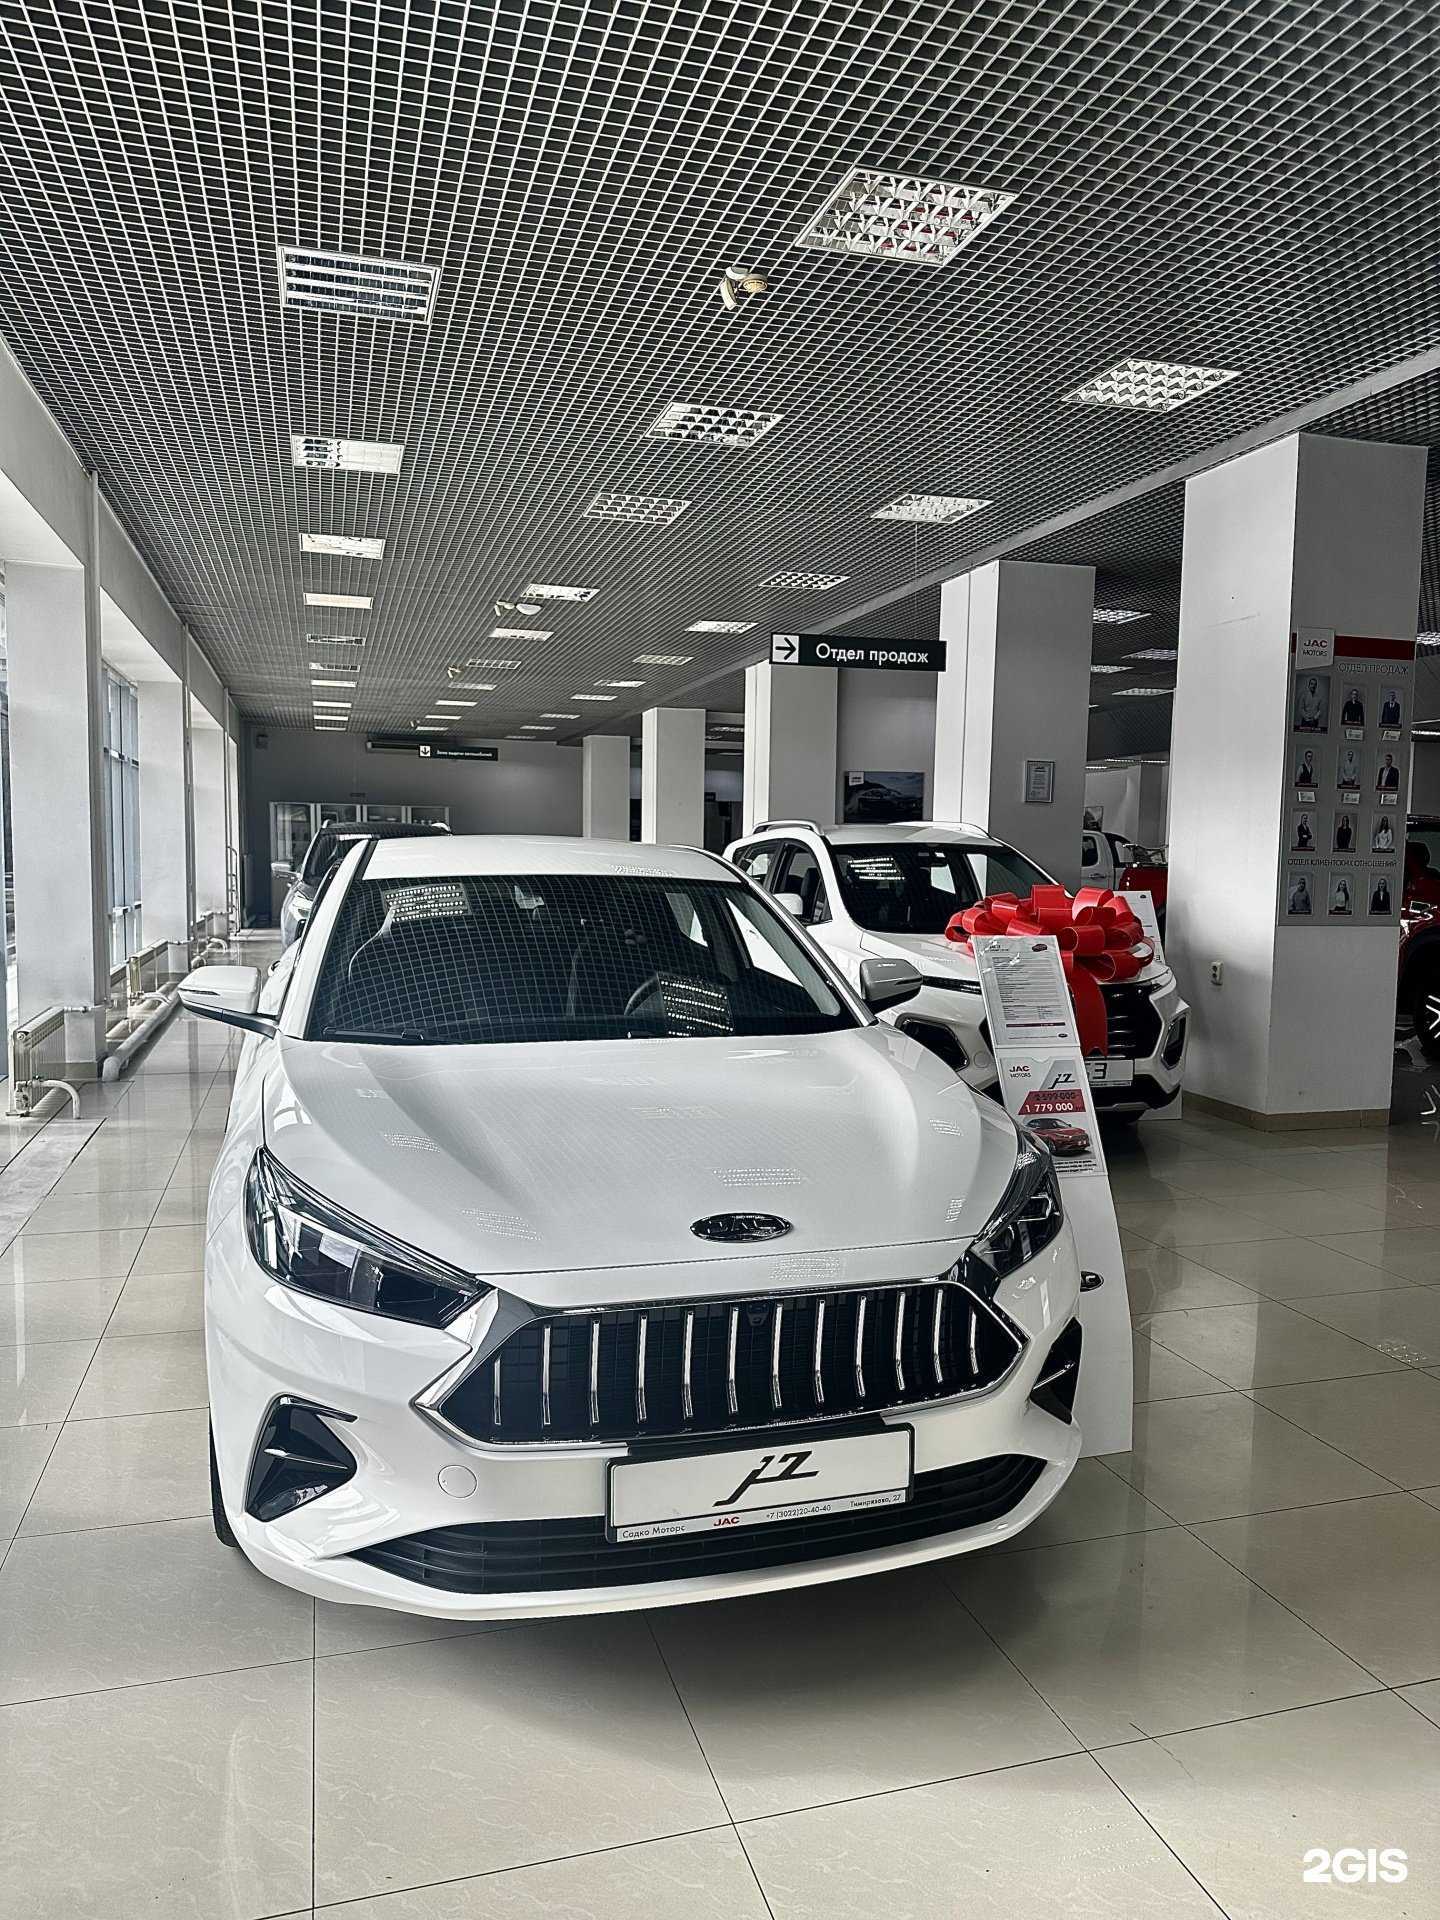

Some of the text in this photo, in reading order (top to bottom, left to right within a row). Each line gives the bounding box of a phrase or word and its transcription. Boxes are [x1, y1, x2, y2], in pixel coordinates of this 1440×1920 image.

[1303, 639, 1328, 648] JAC
[815, 642, 929, 666] Отдел продаж
[1302, 649, 1328, 657] MOTORS
[1338, 662, 1409, 675] ОТДЕЛ ПРОДАЖ
[1008, 1065, 1030, 1073] JAC
[1034, 1103, 1053, 1113] 779
[1055, 1102, 1073, 1111] 000
[713, 1516, 740, 1527] JAC
[622, 1525, 686, 1540] Садко Моторс
